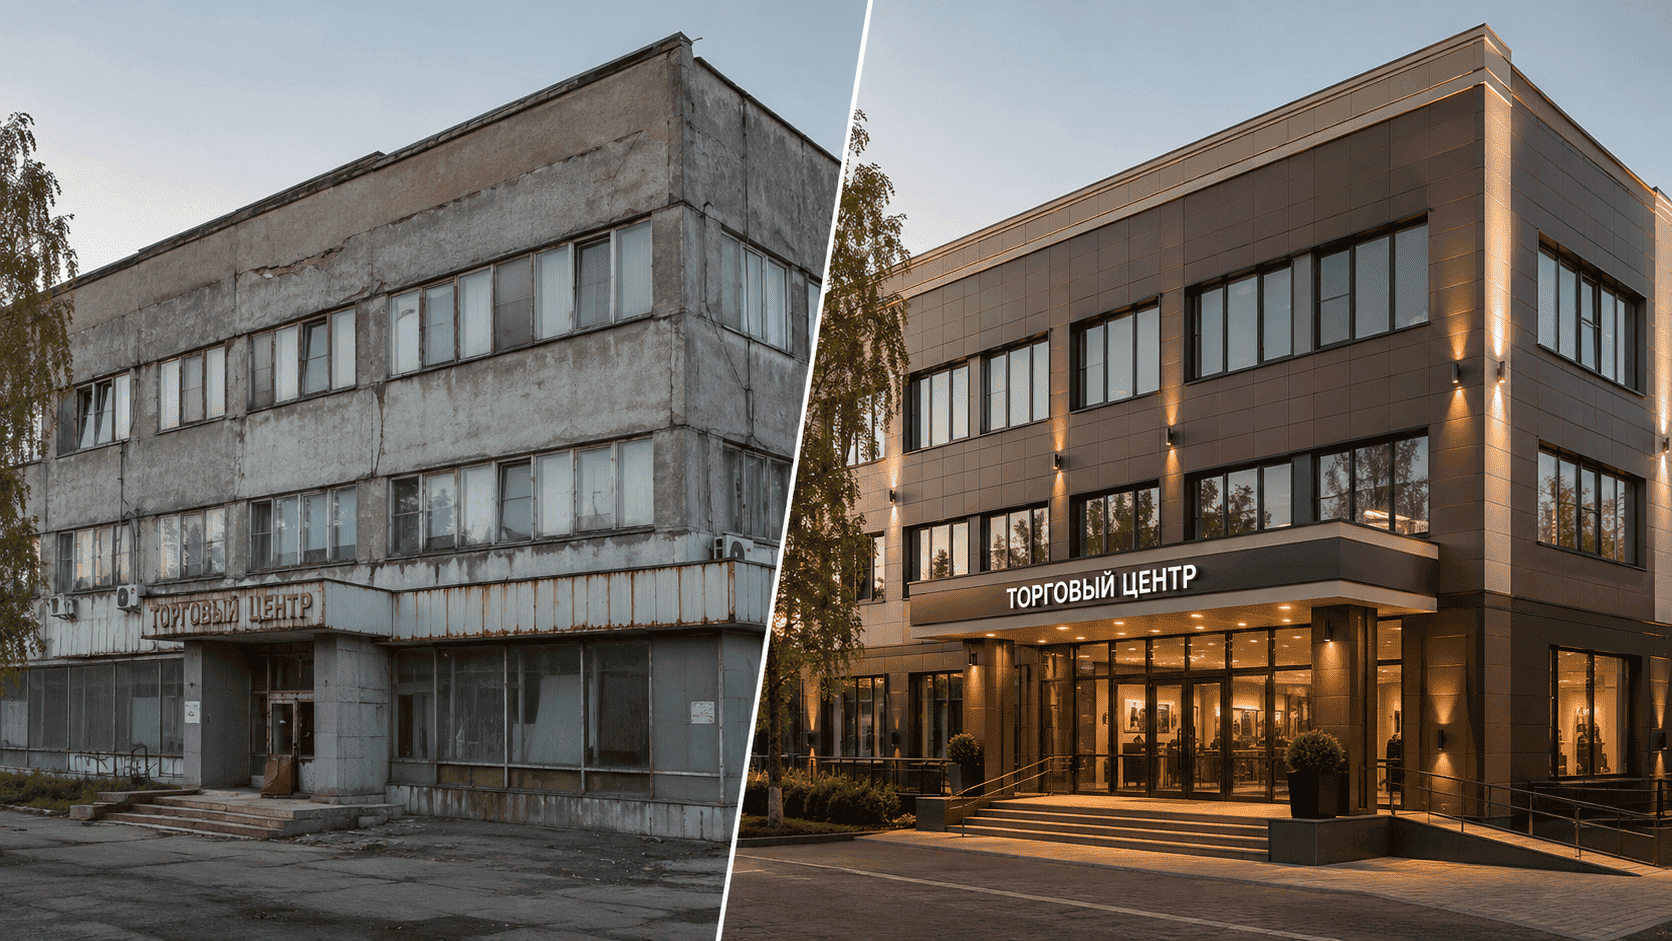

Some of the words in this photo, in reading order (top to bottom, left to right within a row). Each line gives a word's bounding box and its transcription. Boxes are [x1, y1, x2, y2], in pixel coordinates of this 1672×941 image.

[1006, 571, 1115, 609] ТОРГОВЫЙ
[1123, 564, 1197, 598] ЦЕНТР
[150, 596, 239, 629] ТОРГОВЫЙ
[249, 592, 312, 623] ЦЕНТР
